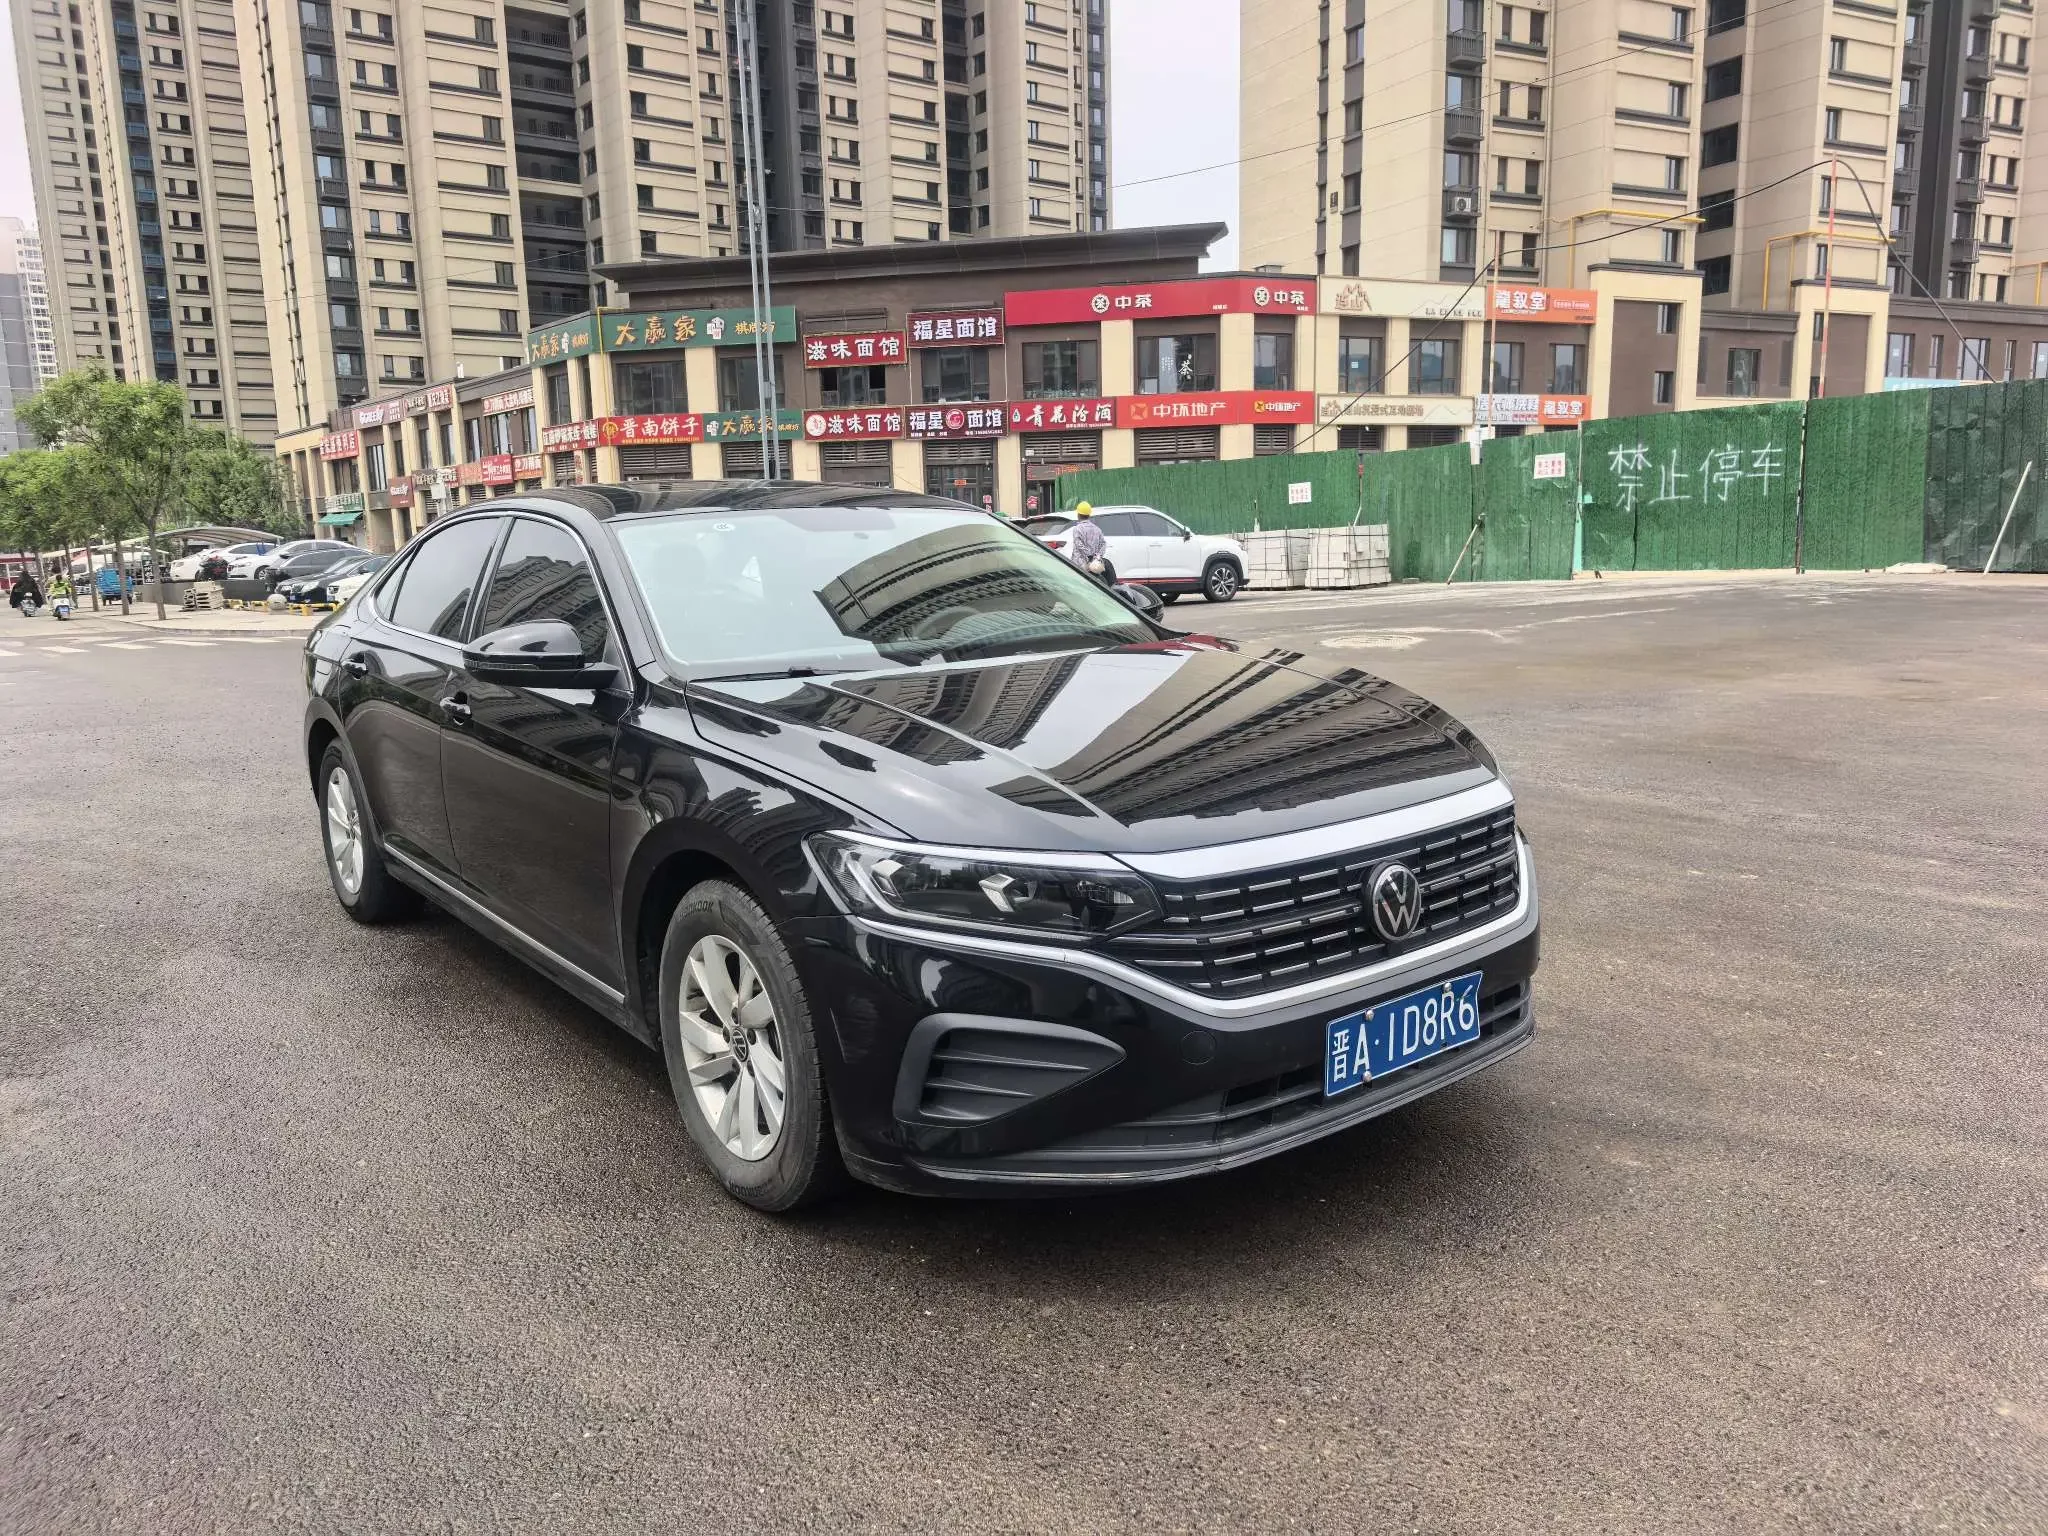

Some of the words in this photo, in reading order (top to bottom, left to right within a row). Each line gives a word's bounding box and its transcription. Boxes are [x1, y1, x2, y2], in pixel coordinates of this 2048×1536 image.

[1115, 294, 1153, 309] 中茶
[1273, 290, 1305, 305] 中茶
[614, 315, 697, 346] 大赢家
[913, 316, 997, 341] 福星面馆
[806, 337, 900, 362] 滋味面馆
[1153, 402, 1227, 418] 中环地产
[1265, 402, 1302, 413] 中环地产
[620, 416, 700, 438] 晋南饼子
[827, 408, 901, 434] 滋味面馆
[909, 410, 944, 431] 福星
[967, 408, 1003, 428] 面馆
[1607, 441, 1783, 513] 禁止停车
